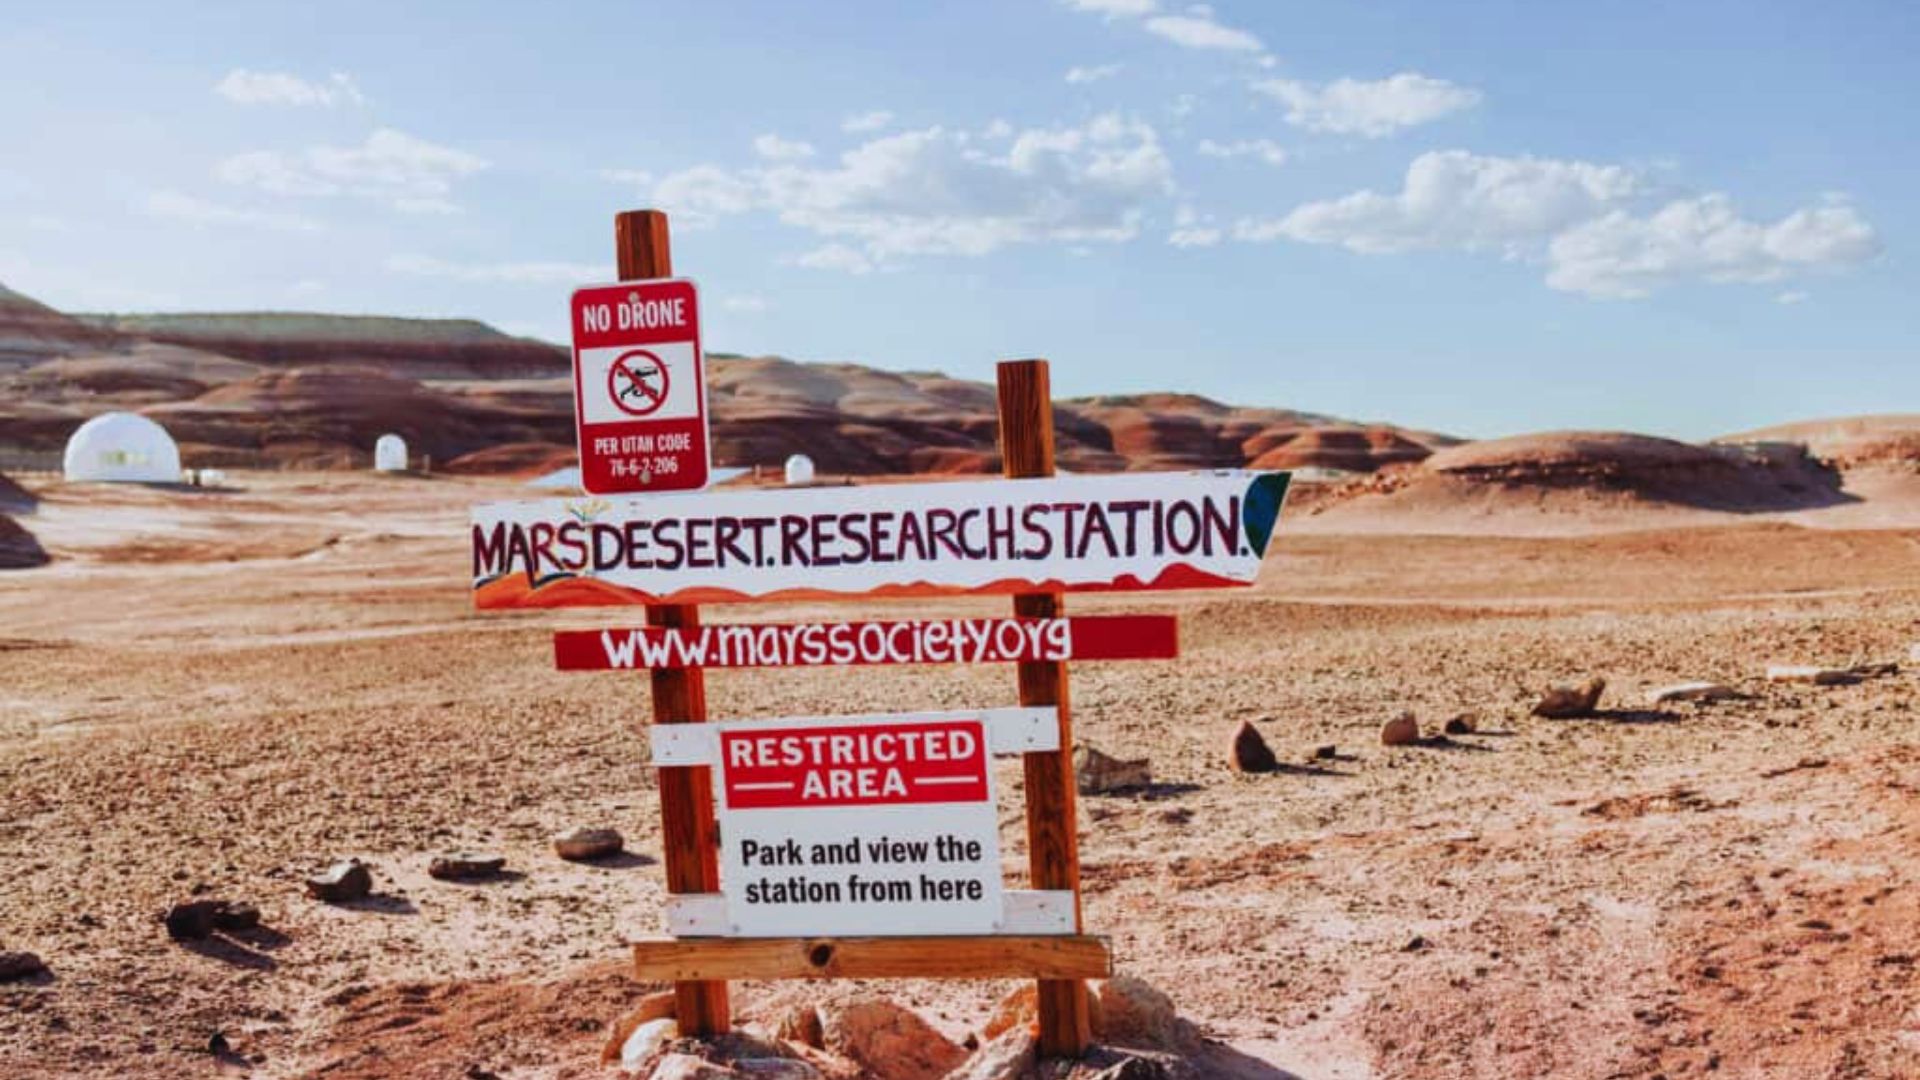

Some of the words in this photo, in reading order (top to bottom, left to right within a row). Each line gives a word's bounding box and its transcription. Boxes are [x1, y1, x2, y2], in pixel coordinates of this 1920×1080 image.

[583, 304, 611, 333] NO
[618, 298, 686, 330] DRONE
[594, 437, 618, 455] PER
[622, 435, 653, 454] UTAH
[657, 432, 690, 451] CODE
[729, 729, 977, 768] RESTRICTED
[801, 768, 908, 799] AREA
[742, 839, 803, 866] Park
[811, 837, 861, 863] and
[868, 836, 929, 862] view
[935, 835, 982, 861] the
[745, 878, 841, 903] station
[848, 875, 912, 901] from
[920, 874, 983, 900] here
